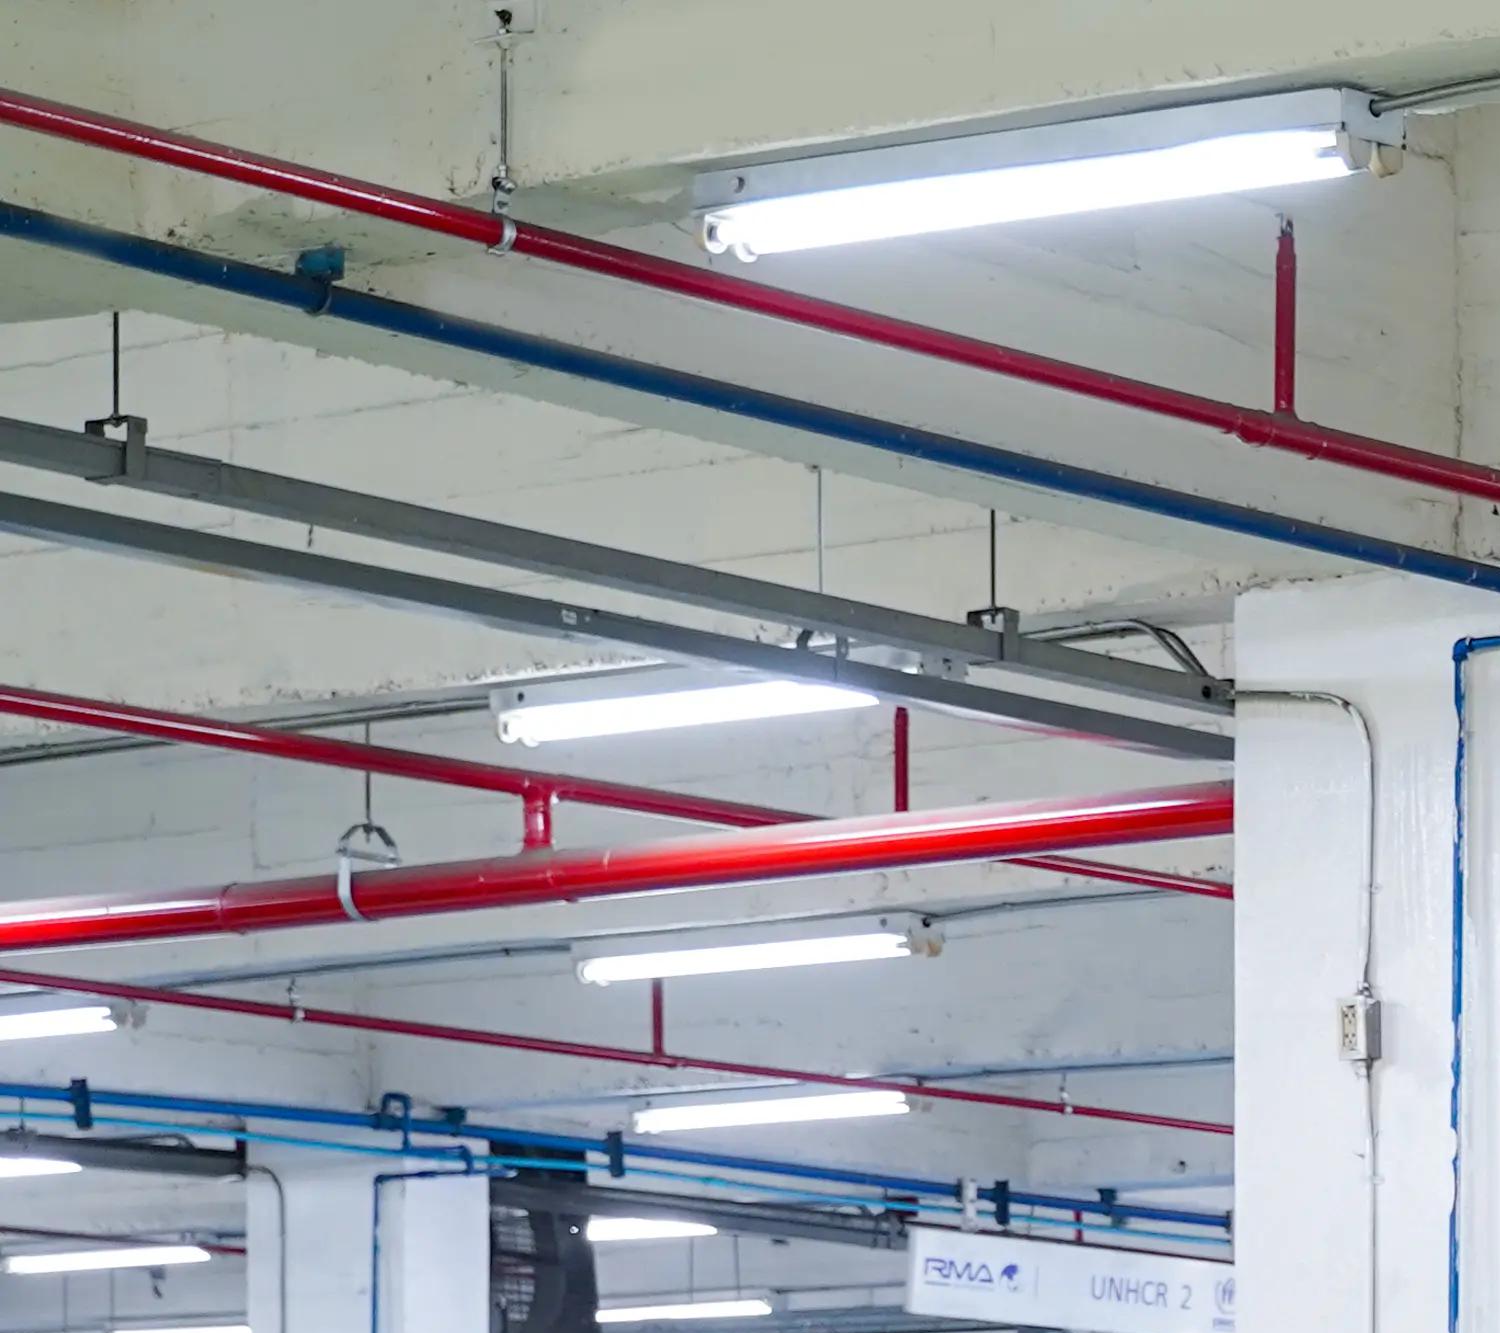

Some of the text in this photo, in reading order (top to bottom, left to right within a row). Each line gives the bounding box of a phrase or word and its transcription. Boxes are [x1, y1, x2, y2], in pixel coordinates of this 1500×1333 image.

[924, 1258, 994, 1283] RMA
[1091, 1275, 1193, 1310] UNHCR 2
